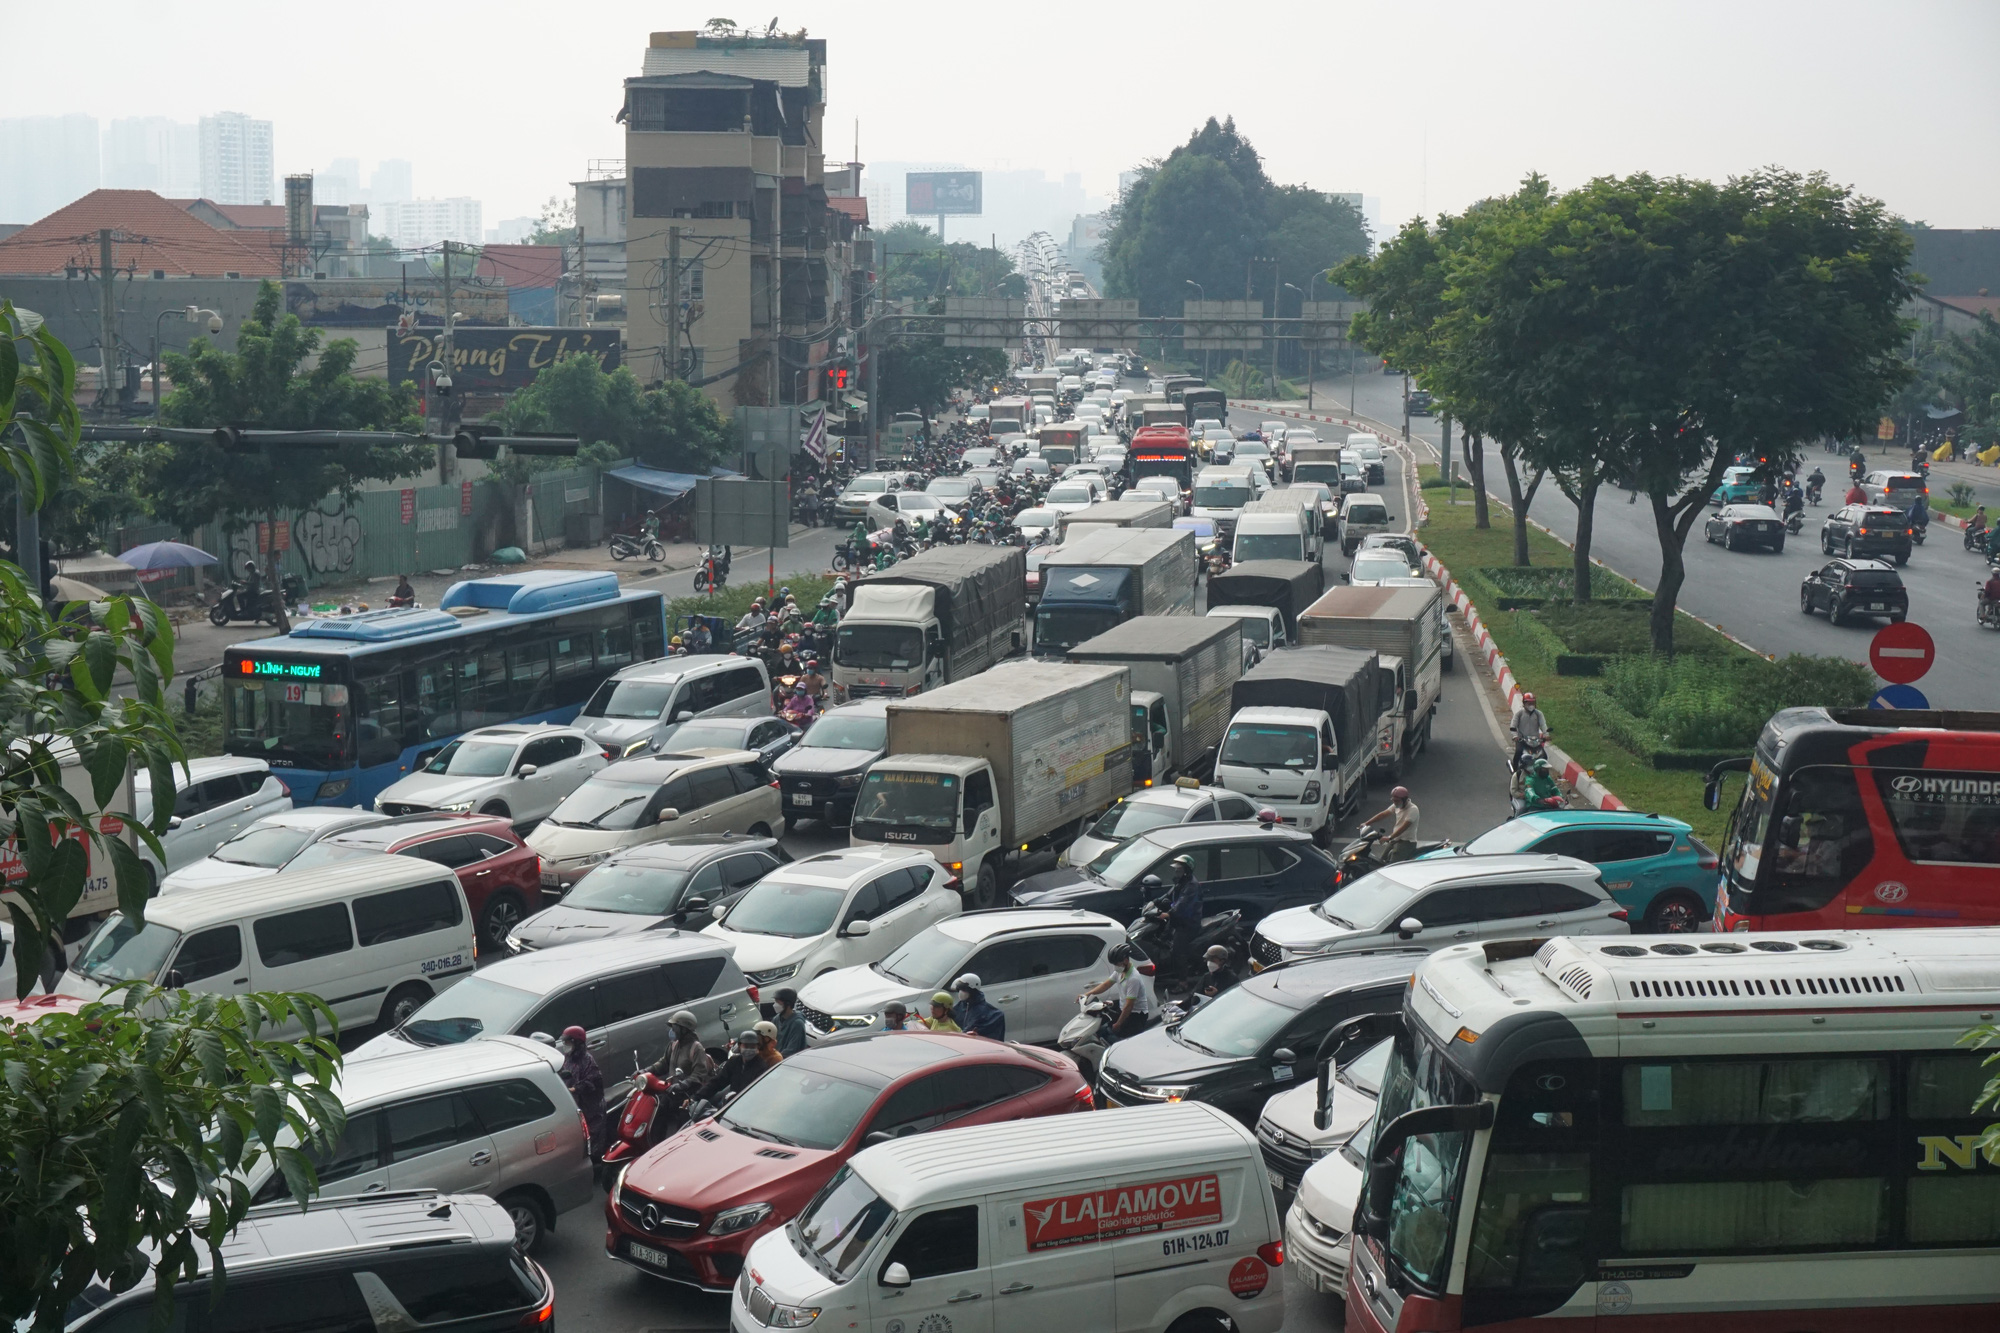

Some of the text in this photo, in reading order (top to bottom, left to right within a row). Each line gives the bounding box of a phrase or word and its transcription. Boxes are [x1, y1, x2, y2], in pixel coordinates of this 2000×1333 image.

[509, 333, 608, 367] Th
[286, 685, 301, 701] 19
[884, 832, 917, 841] ISUZU
[421, 954, 462, 974] 34D-016.28
[1060, 1178, 1216, 1225] LALAMOVE
[1098, 1219, 1119, 1229] Giao
[1120, 1214, 1142, 1226] hàng
[1142, 1212, 1160, 1222] siêu
[1160, 1209, 1175, 1219] tốc
[1231, 1273, 1267, 1284] LALAMOVE
[1600, 1270, 1644, 1280] THACO
